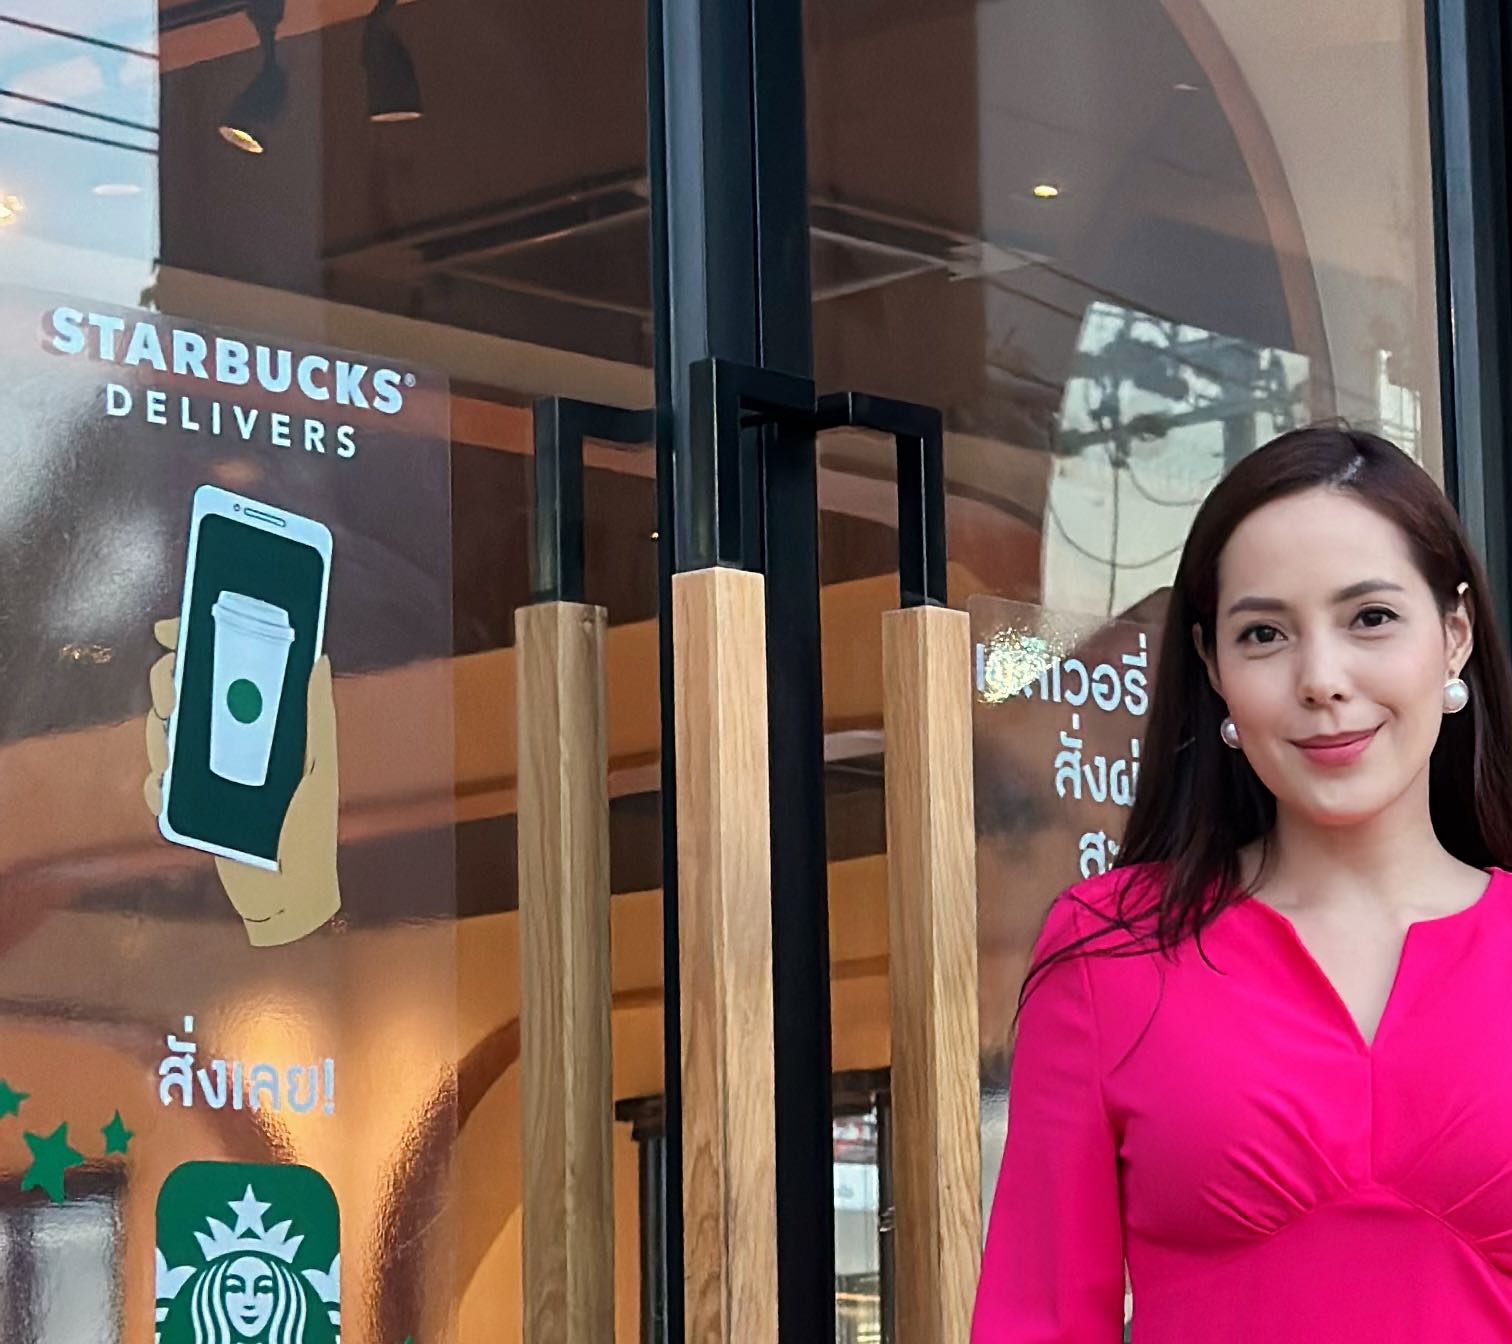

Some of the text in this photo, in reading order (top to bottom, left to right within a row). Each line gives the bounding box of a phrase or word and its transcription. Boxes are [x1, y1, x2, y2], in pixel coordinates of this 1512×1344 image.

[105, 383, 356, 458] DELIVERS
[159, 1016, 335, 1115] สั่งเลย!
